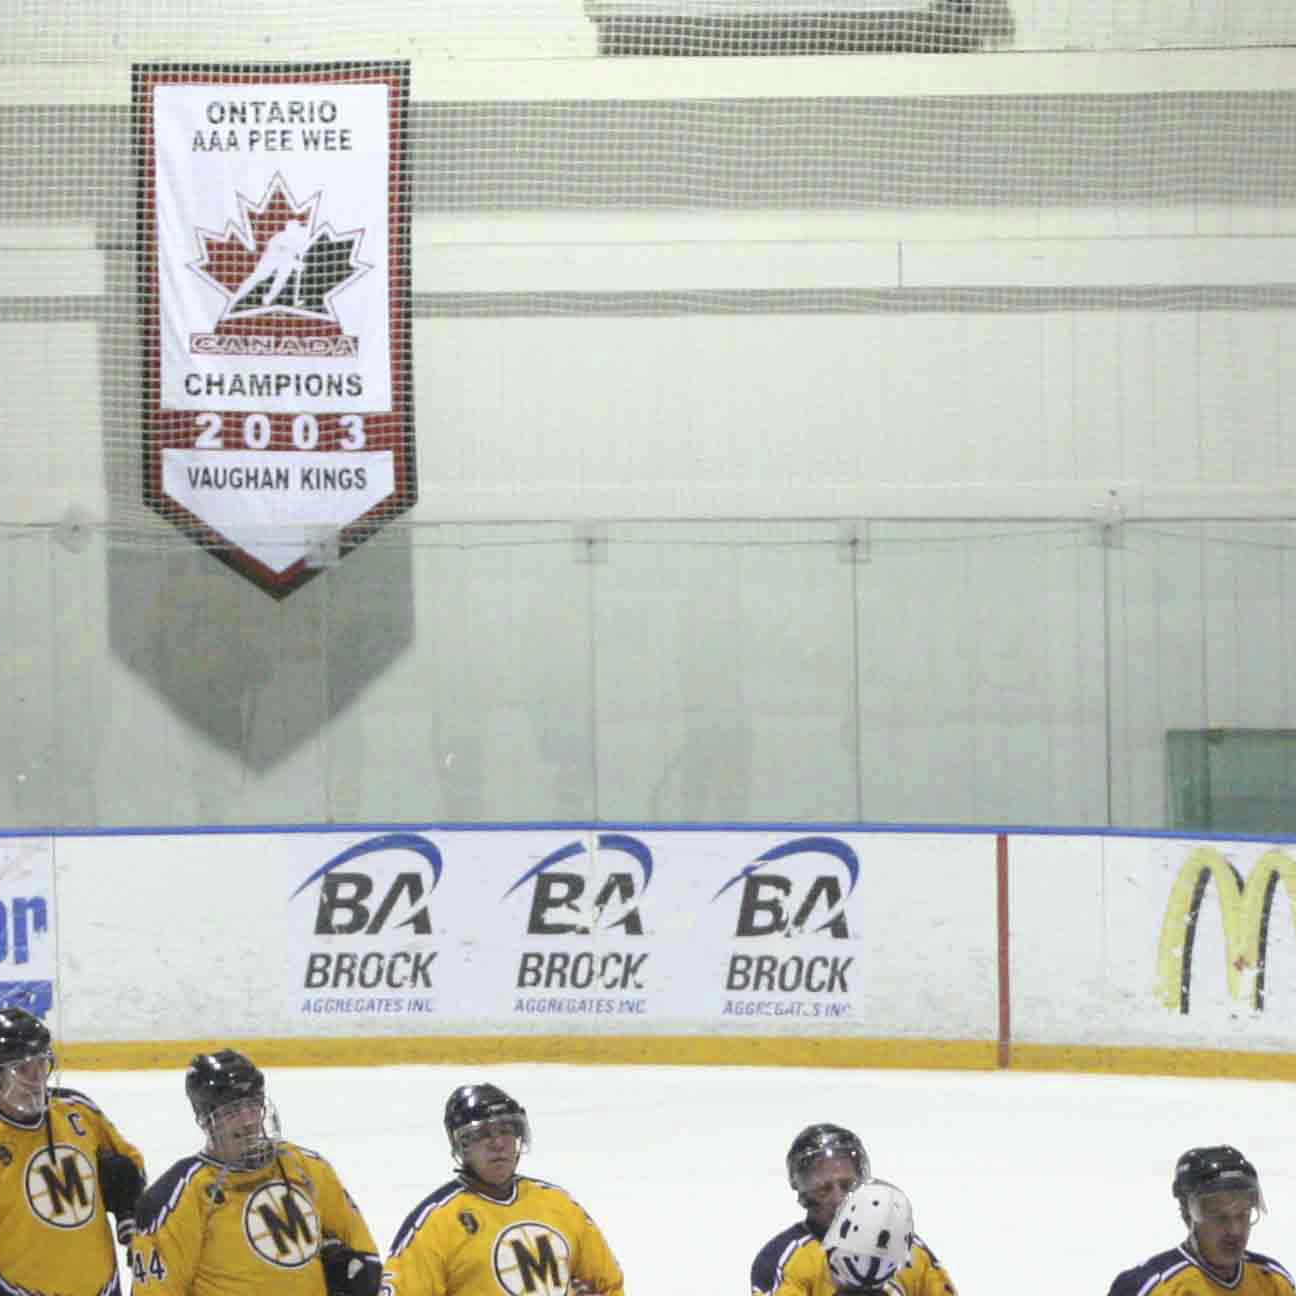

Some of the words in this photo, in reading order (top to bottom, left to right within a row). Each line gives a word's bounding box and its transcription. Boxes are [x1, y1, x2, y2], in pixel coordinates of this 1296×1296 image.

[205, 100, 338, 125] ONTARIO
[192, 130, 240, 151] AAA
[248, 129, 294, 151] PEE
[302, 129, 353, 151] WEE
[193, 335, 359, 357] CANADA
[184, 373, 364, 398] CHAMPIONS
[194, 413, 368, 449] 2003
[187, 467, 290, 490] VAUGHAN
[300, 467, 368, 490] KINGS
[314, 871, 433, 935] BA
[735, 874, 850, 939] BA
[303, 951, 439, 989] BROCK
[516, 951, 650, 990] BROCK
[725, 953, 856, 993] BROCK
[39, 1160, 90, 1217] M
[258, 1193, 314, 1255] M
[510, 1234, 562, 1293] M
